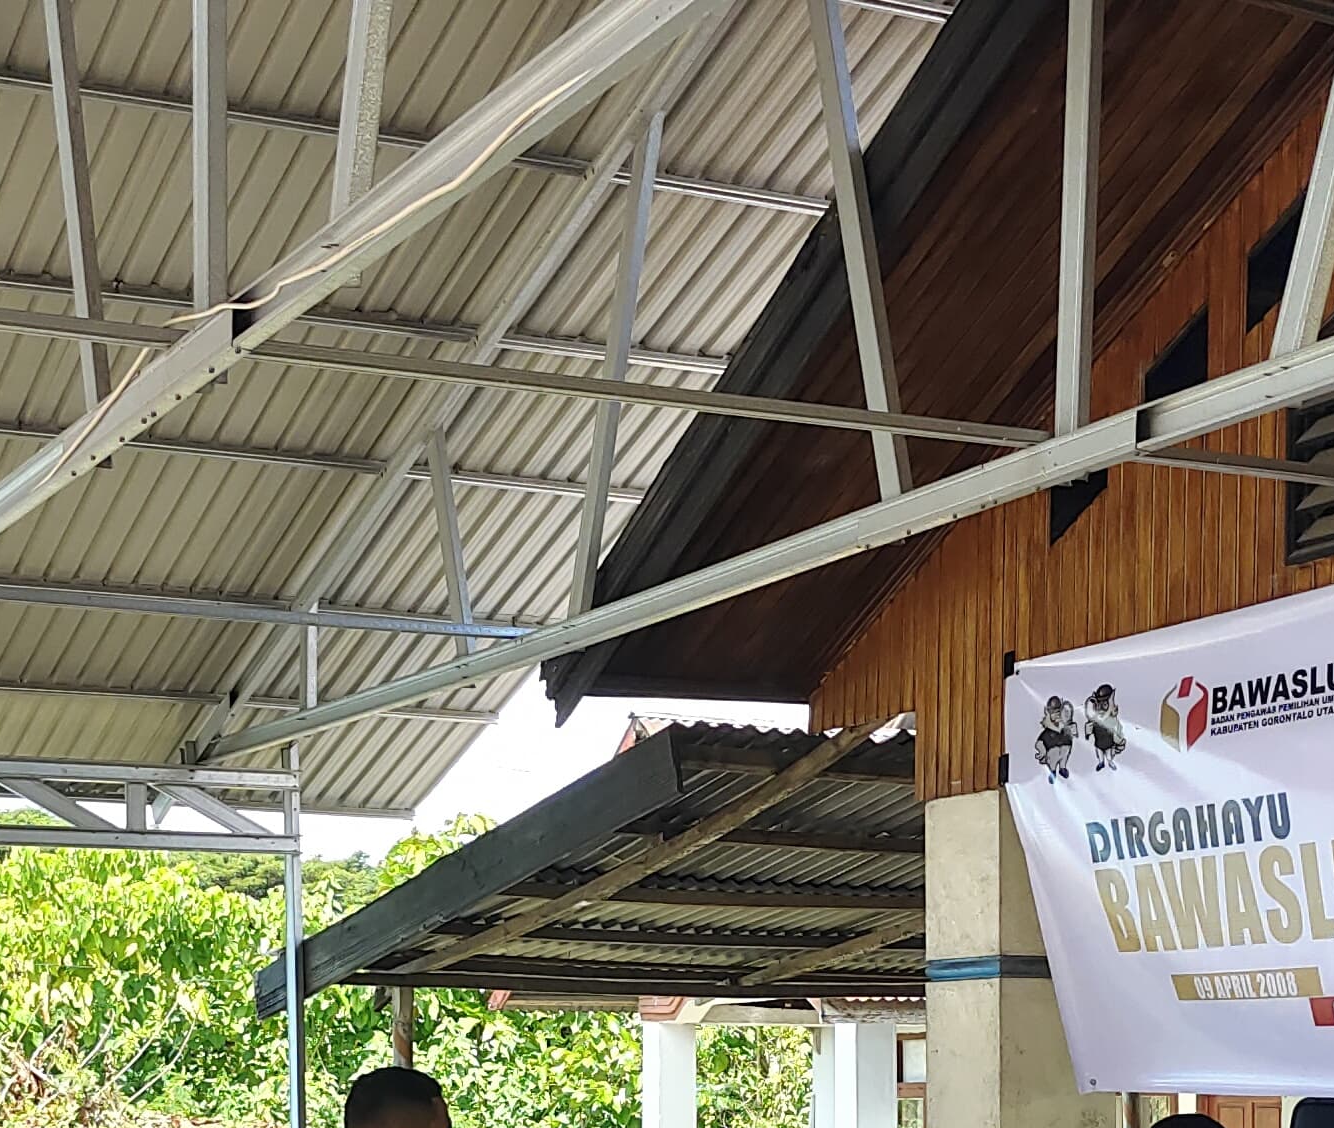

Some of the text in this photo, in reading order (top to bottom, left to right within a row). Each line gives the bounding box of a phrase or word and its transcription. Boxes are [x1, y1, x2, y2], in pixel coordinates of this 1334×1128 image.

[1210, 720, 1259, 736] KABUPATEN
[1262, 710, 1314, 727] GORONTALO
[1211, 714, 1235, 726] BADAN
[1237, 705, 1277, 720] PENGAWAS
[1279, 698, 1320, 712] PEMILIHAN
[1085, 792, 1291, 863] DIRGAHAYU
[1194, 971, 1298, 999] 09 APRIL 2008
